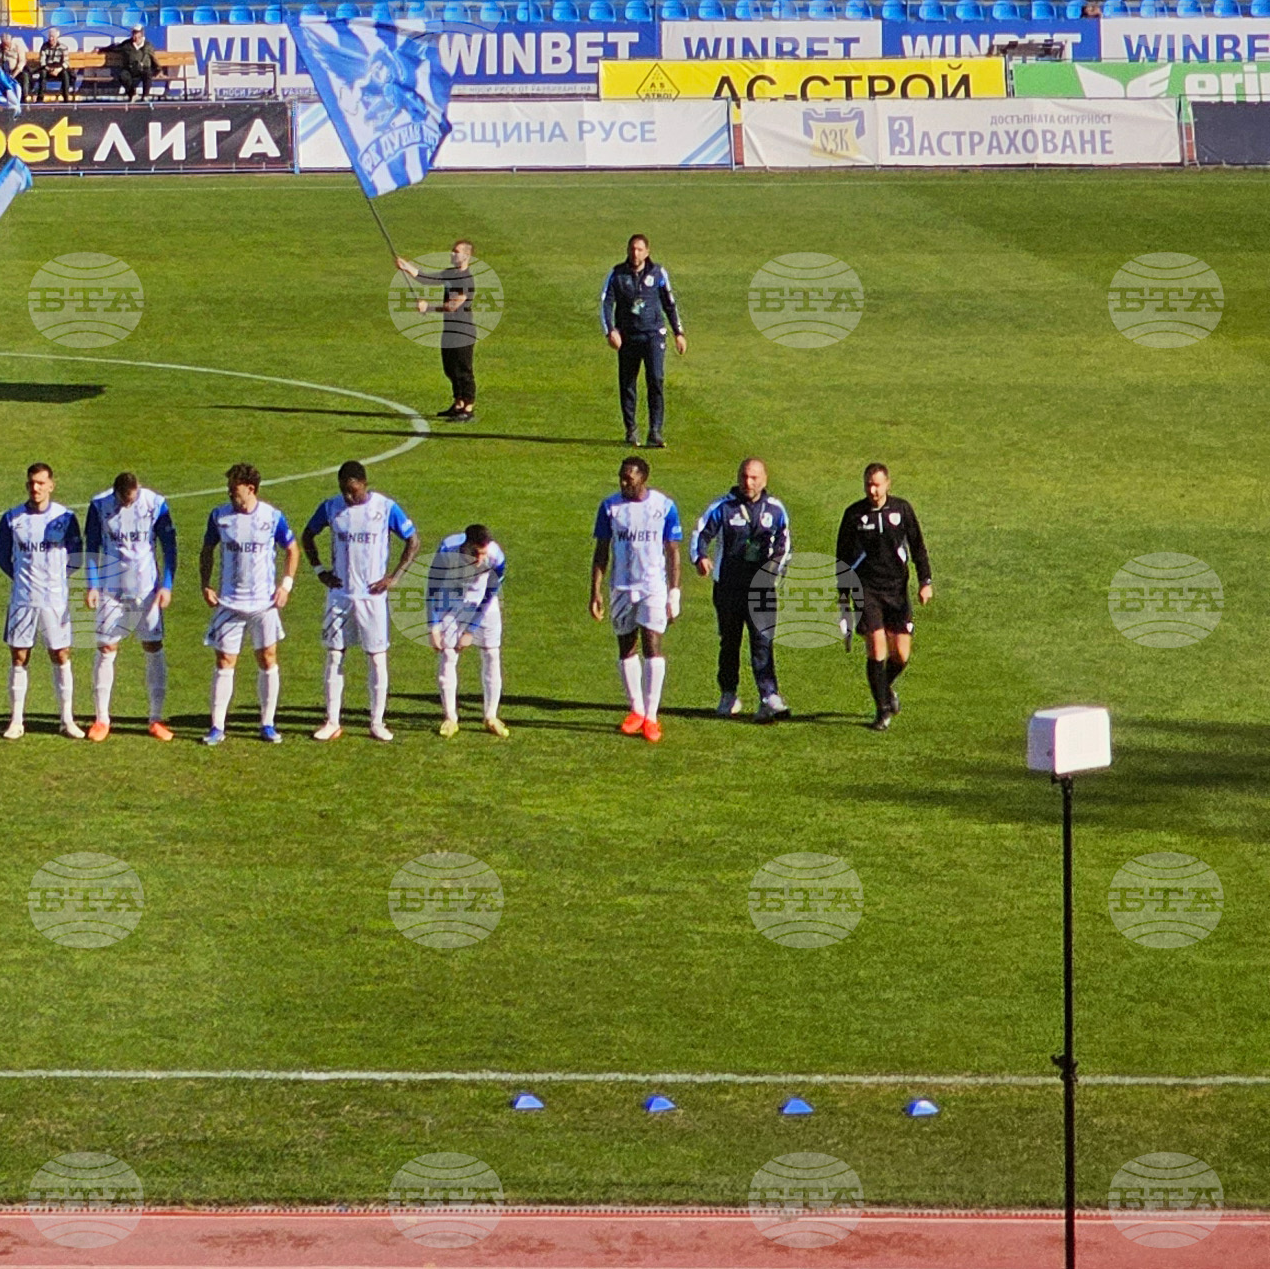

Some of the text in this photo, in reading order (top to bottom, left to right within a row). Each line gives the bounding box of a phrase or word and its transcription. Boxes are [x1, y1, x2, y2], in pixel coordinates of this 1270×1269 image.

[439, 32, 639, 76] WINBET
[93, 118, 281, 162] ЛИГА
[450, 120, 568, 148] БЩИНА
[578, 119, 657, 143] РУСЕ
